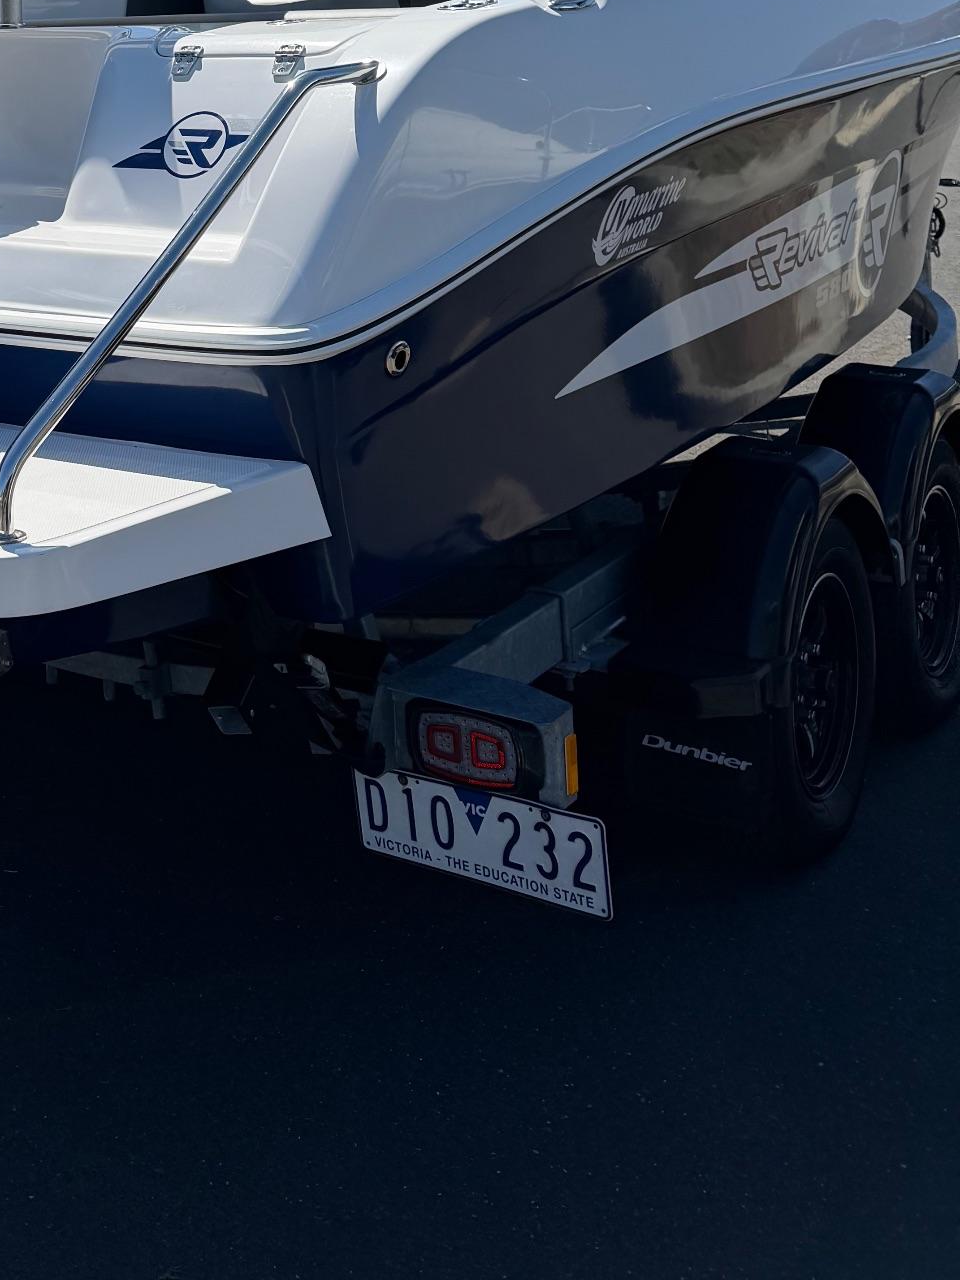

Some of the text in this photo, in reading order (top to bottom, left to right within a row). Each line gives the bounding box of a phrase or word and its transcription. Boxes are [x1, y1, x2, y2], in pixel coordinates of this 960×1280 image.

[616, 238, 648, 260] AUSTRALIA
[621, 211, 663, 244] WORLD
[748, 198, 858, 292] Revival
[641, 734, 753, 771] Dunbier
[374, 835, 433, 862] VICTORIA
[445, 855, 470, 872] THE
[474, 863, 549, 897] EDUCATION
[553, 886, 595, 910] STATE
[497, 811, 597, 893] 232
